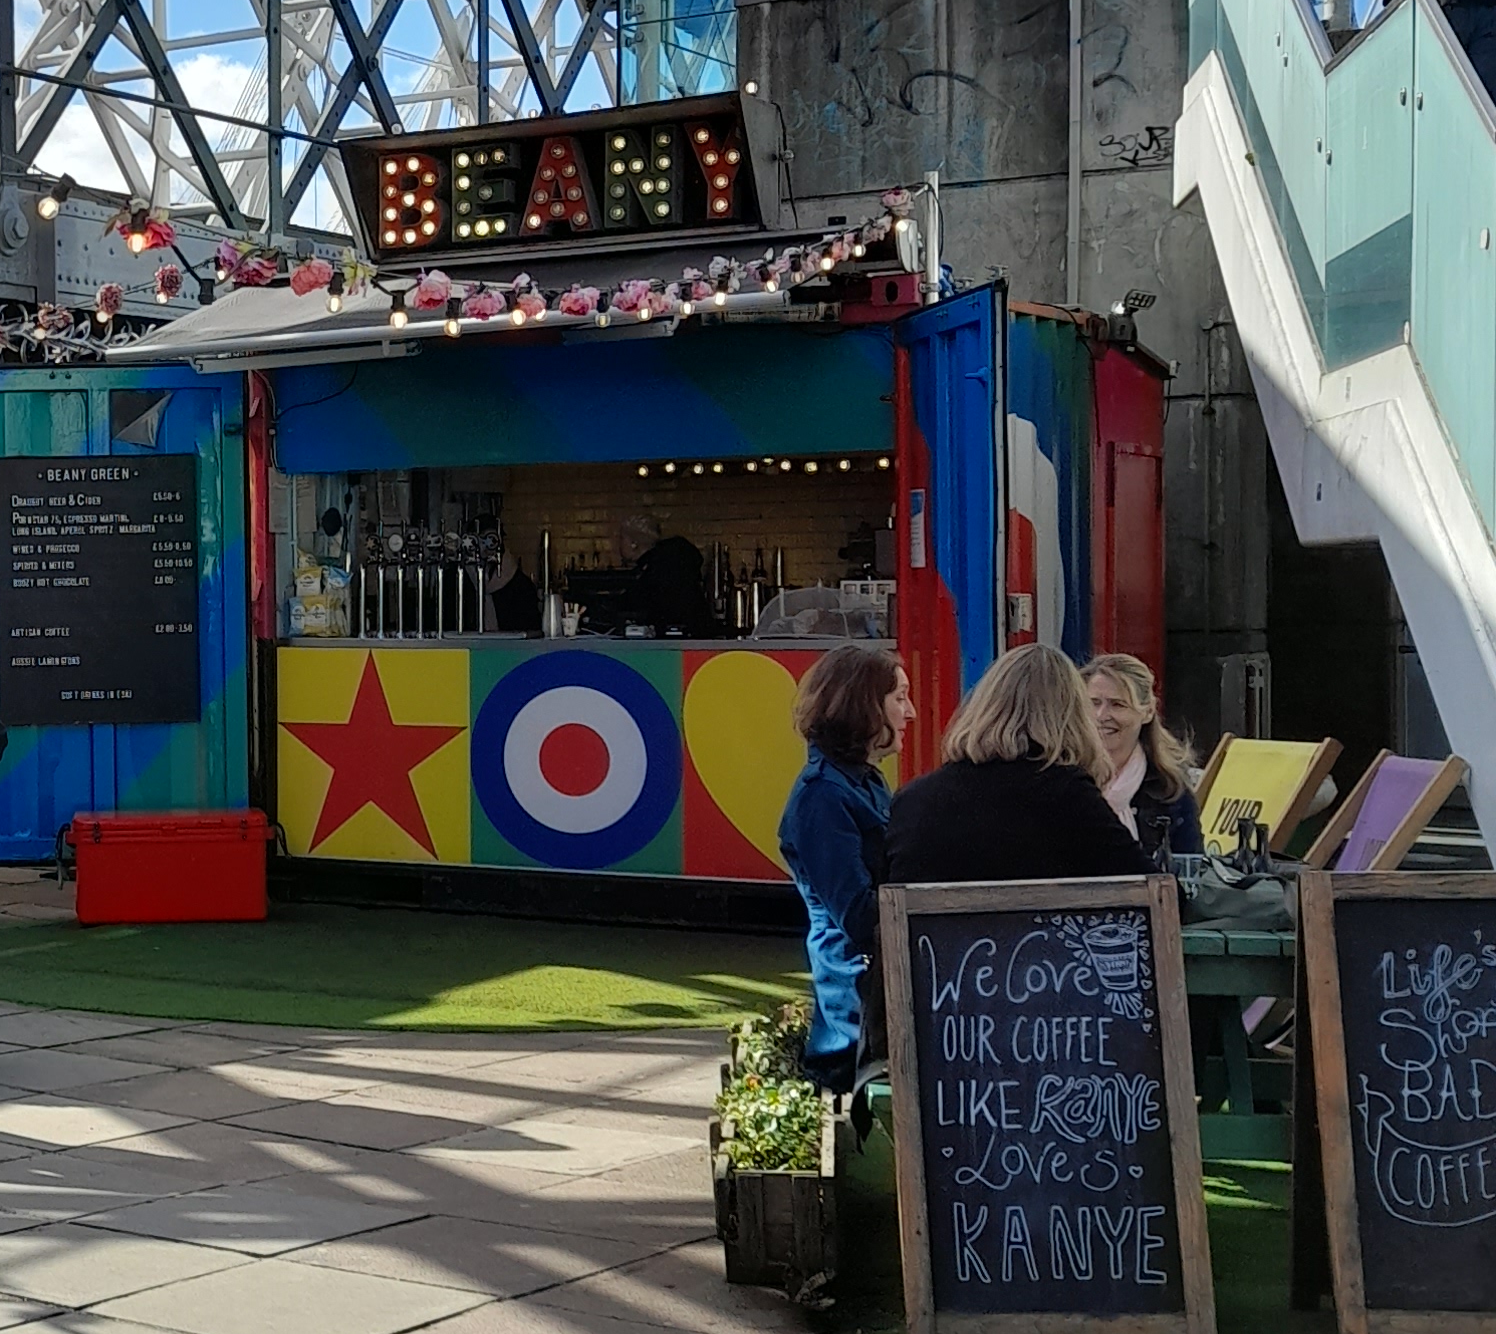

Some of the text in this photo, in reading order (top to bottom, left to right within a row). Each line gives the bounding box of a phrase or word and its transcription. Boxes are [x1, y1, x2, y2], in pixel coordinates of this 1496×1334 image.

[378, 121, 741, 250] BEANY
[47, 467, 130, 481] BEANY GREEN
[68, 494, 76, 506] &
[918, 934, 999, 1012] We
[942, 1015, 1118, 1067] OUR COFFEE
[936, 1079, 1024, 1130] LIKE
[1388, 1146, 1496, 1210] COFFE
[953, 1201, 1168, 1285] KANYE
